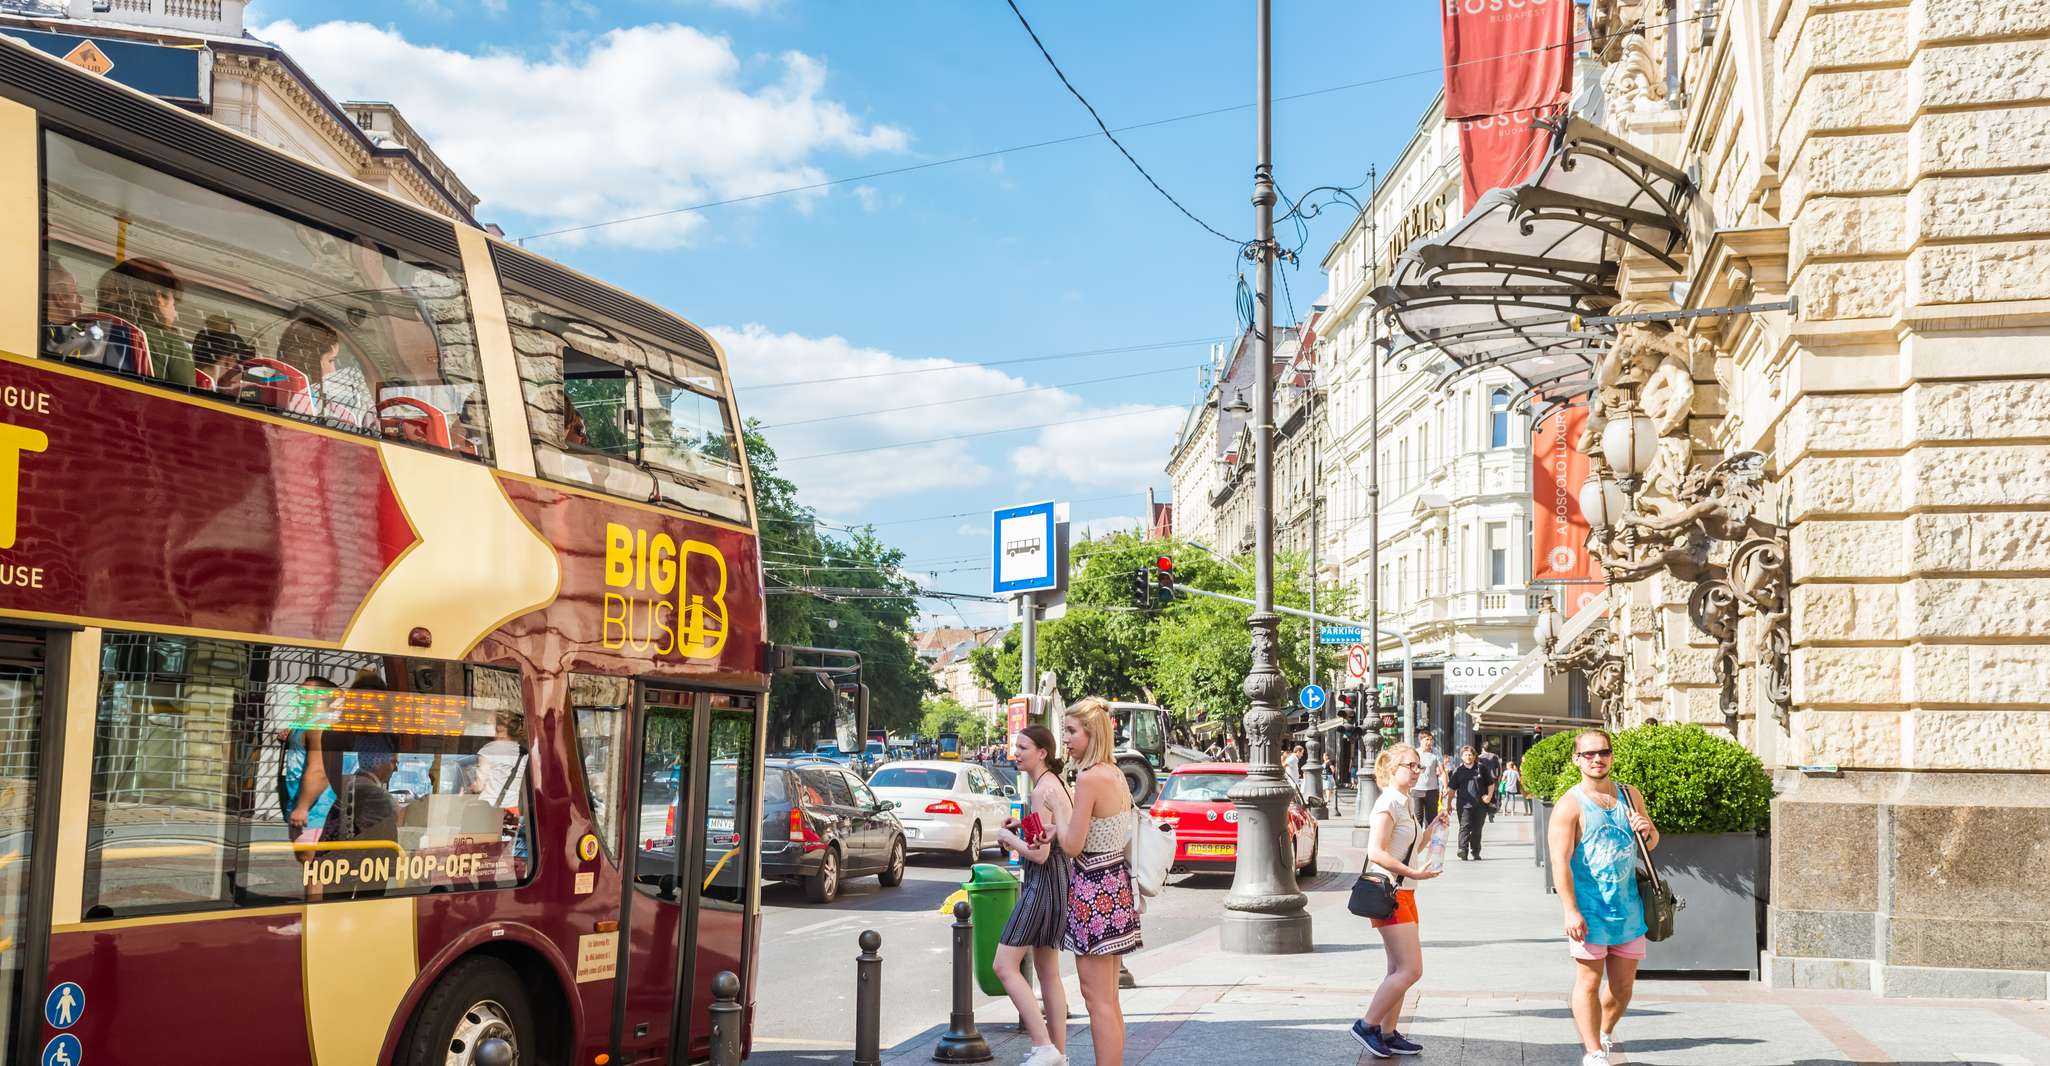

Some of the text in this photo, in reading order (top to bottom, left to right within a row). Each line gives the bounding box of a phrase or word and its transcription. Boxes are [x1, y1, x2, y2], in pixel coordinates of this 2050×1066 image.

[1446, 0, 1546, 17] BOS
[1490, 8, 1546, 23] BUDAPEST
[0, 386, 50, 414] GUE
[1555, 461, 1568, 523] BOSCOLO
[1556, 523, 1568, 536] A
[605, 522, 677, 595] BIG
[603, 592, 674, 655] BUS
[1321, 627, 1361, 635] PARKING
[1226, 812, 1239, 821] GB
[303, 857, 390, 886] HOP-ON
[395, 852, 482, 881] HOP-OFF
